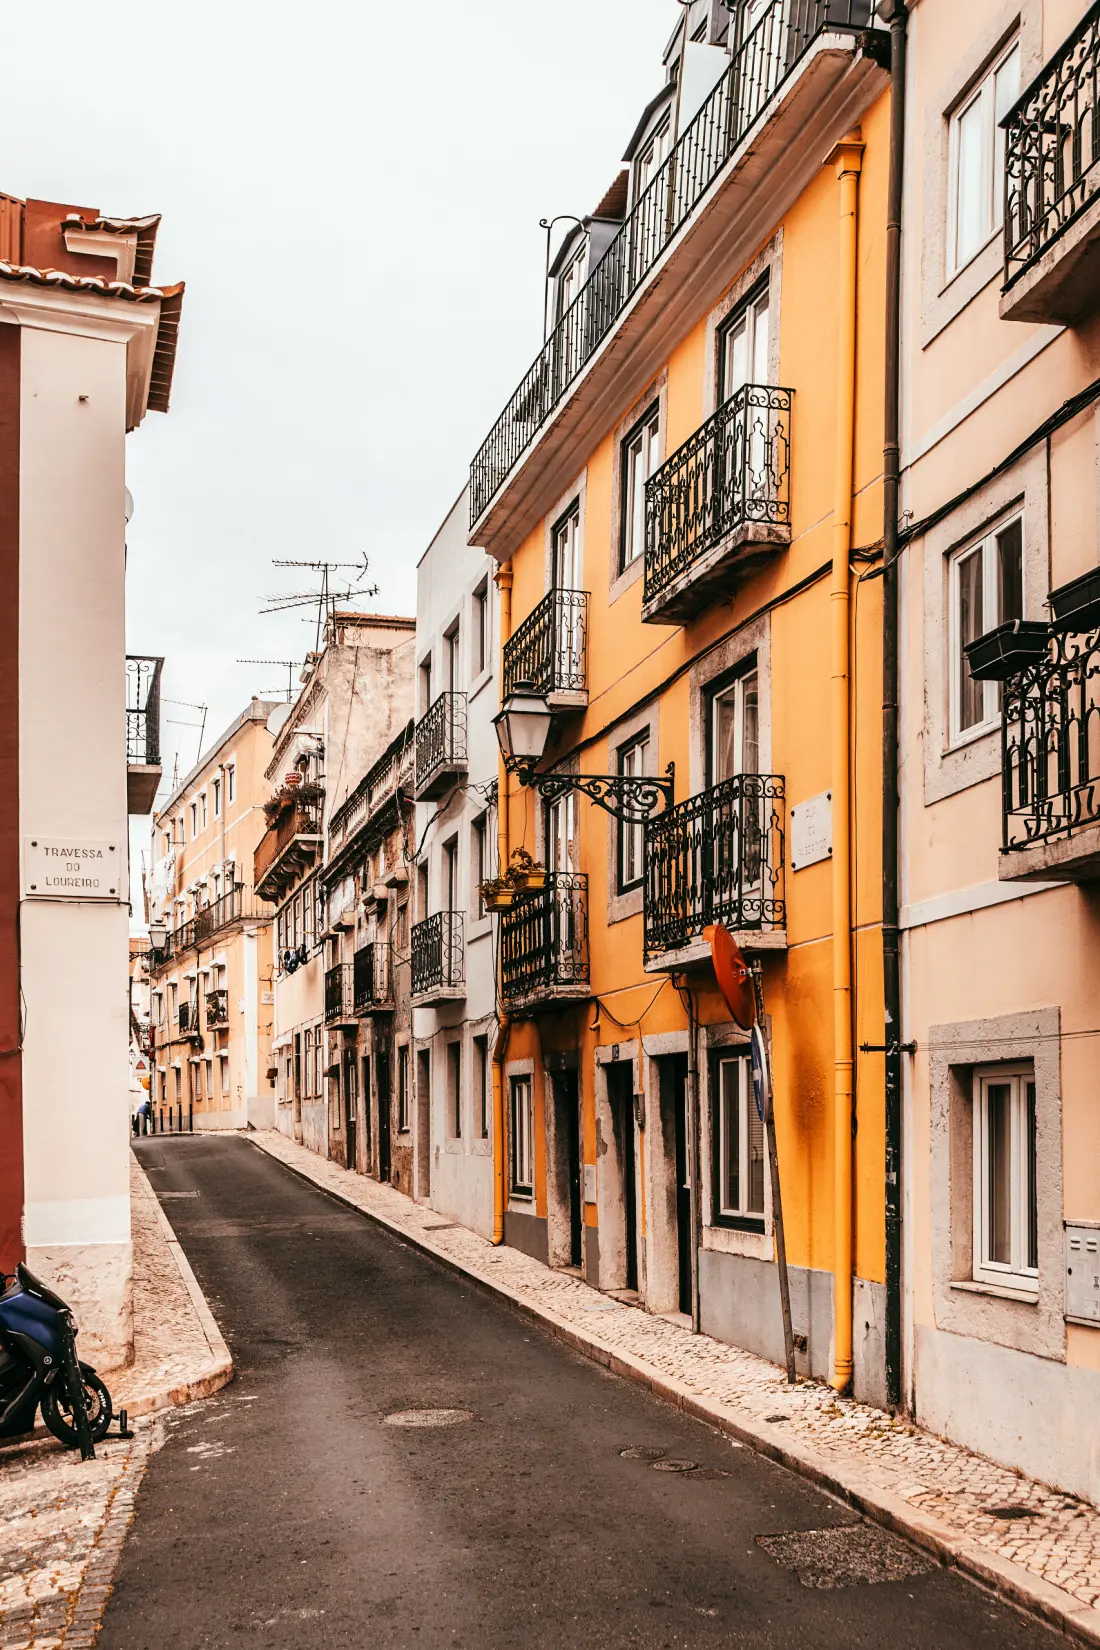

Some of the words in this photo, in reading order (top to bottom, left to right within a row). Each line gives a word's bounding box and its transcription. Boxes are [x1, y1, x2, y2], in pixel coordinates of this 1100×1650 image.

[44, 847, 103, 859] TRAVESSA
[66, 862, 80, 872] DO
[45, 876, 100, 888] LOUREIRO
